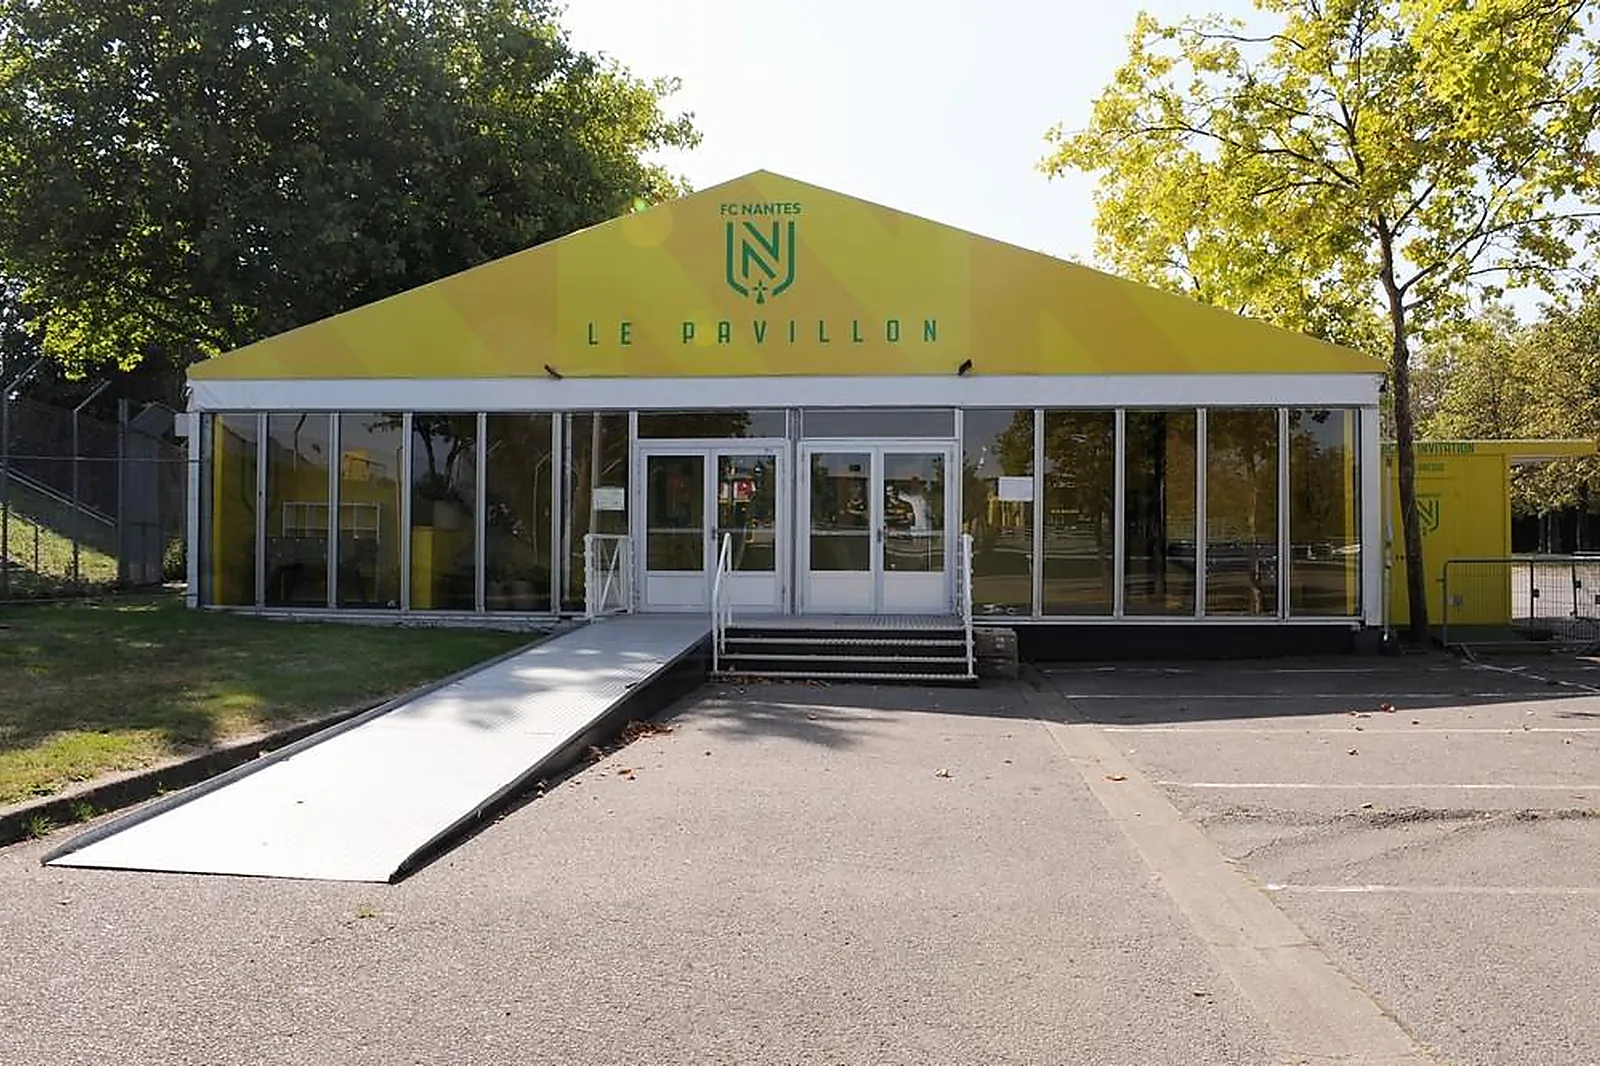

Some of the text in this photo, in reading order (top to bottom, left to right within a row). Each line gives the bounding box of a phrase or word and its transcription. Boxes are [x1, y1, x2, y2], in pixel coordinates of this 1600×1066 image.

[720, 202, 801, 215] FC NANTES
[588, 320, 937, 345] LE PAVILLON
